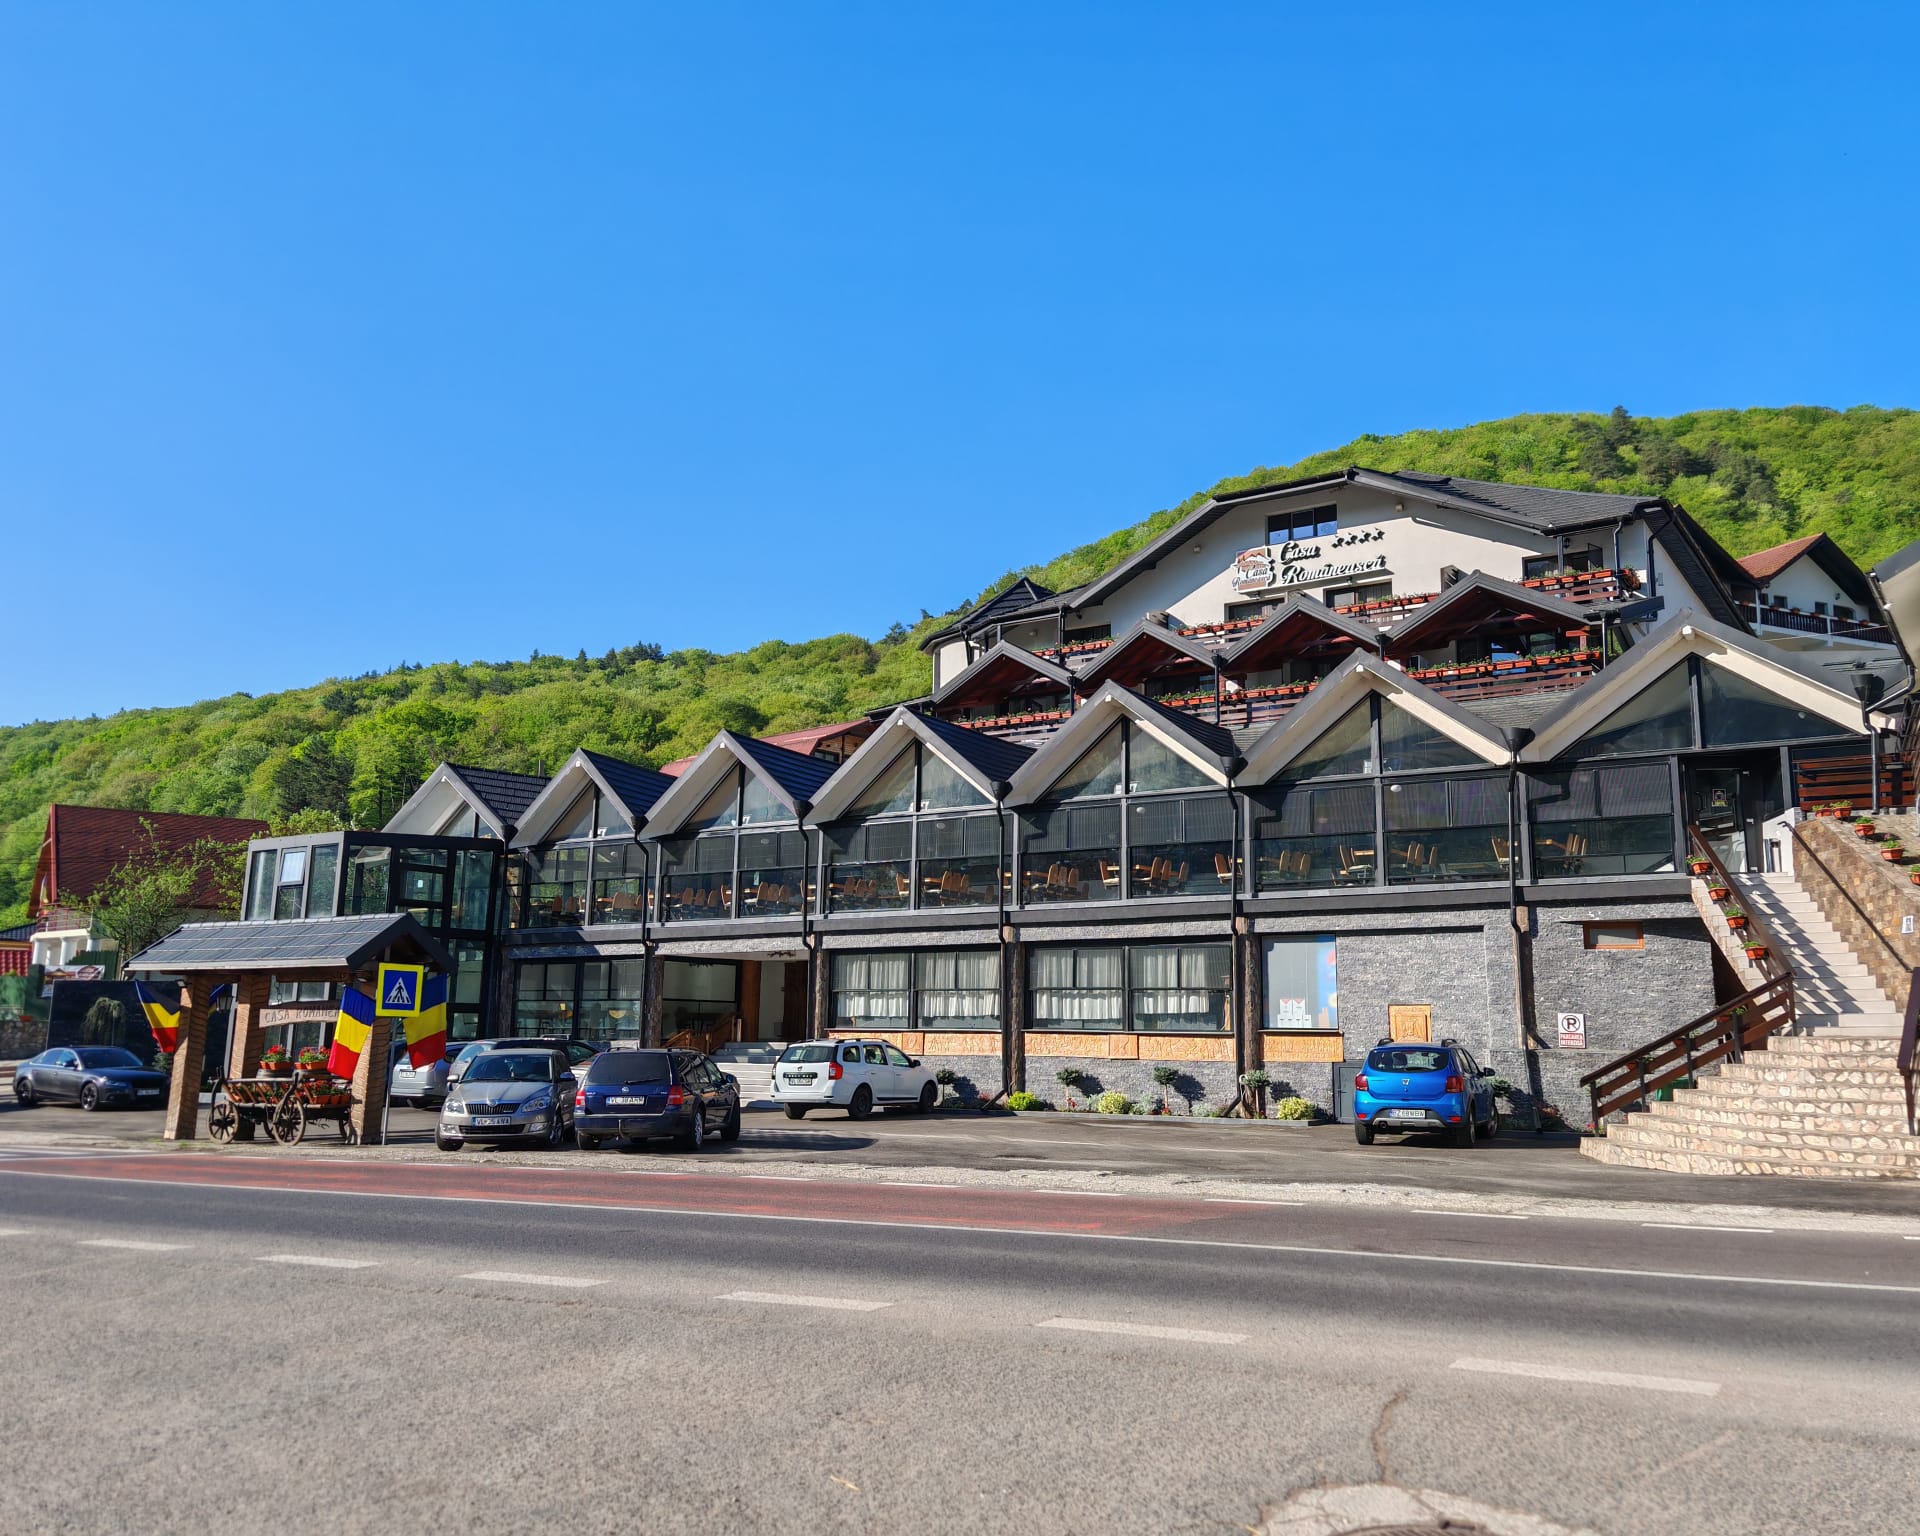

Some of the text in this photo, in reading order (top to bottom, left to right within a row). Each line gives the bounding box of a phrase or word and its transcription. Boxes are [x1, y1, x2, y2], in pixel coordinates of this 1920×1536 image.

[1281, 541, 1319, 565] Casa
[1246, 565, 1269, 579] Casa
[264, 1009, 290, 1023] CASA
